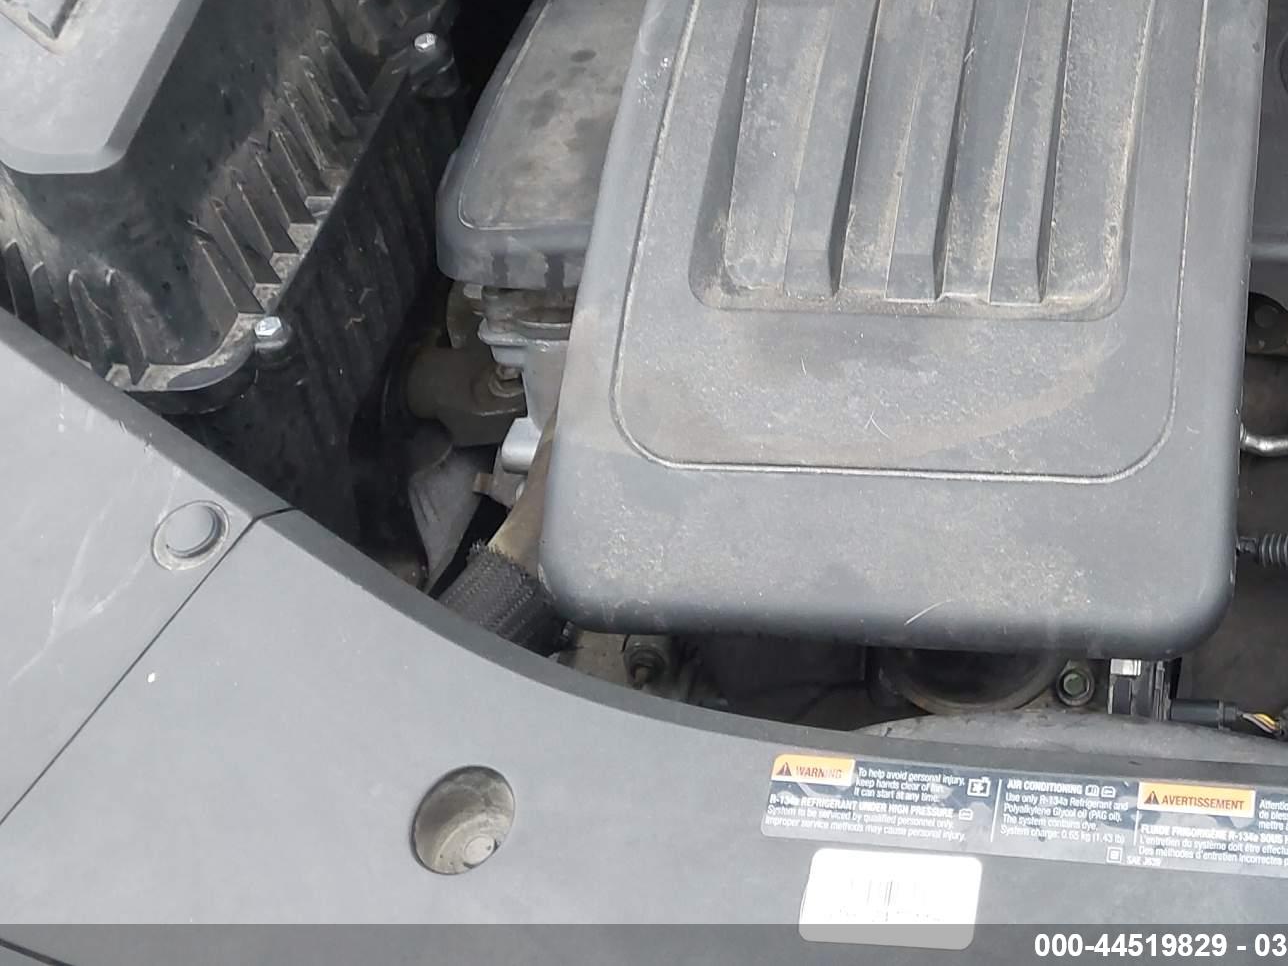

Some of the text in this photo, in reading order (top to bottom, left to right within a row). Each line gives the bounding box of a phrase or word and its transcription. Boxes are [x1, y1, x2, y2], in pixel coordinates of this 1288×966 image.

[795, 766, 842, 779] WARNING
[858, 768, 866, 777] To
[869, 769, 885, 778] help
[886, 771, 907, 779] avoid
[908, 773, 941, 783] personal
[876, 780, 899, 789] hands
[901, 782, 920, 790] clear
[922, 783, 929, 791] of
[1007, 779, 1082, 794] AIR CONDITIONING
[854, 788, 859, 796] It
[877, 790, 894, 798] start
[905, 793, 920, 802] any
[1006, 792, 1128, 810] Use only R-134a Refrigerant and
[1162, 795, 1245, 810] AVERTISSEMENT
[770, 793, 954, 818] R-134a REFRIGERANT UNDER HIGH PRESSURE
[1004, 803, 1051, 816] Polyalkylene
[1053, 806, 1076, 818] Glycol
[1077, 808, 1087, 817] oil
[1088, 809, 1105, 820] (PAG
[768, 804, 796, 815] System
[807, 808, 817, 816] be
[818, 809, 851, 819] serviced
[853, 812, 862, 822] by
[863, 814, 896, 825] qualified
[897, 816, 935, 827] personnel
[1259, 810, 1269, 818] de
[765, 816, 800, 827] Improper
[801, 820, 829, 829] service
[831, 822, 864, 832] methods
[865, 825, 882, 834] may
[884, 827, 908, 835] cause
[908, 828, 941, 838] personal
[1003, 814, 1097, 831] The system contains dye.
[1258, 820, 1283, 830] mettre
[1001, 825, 1029, 836] System
[1061, 830, 1078, 840] 0.65
[1081, 831, 1091, 842] kg
[1115, 834, 1125, 844] lb)
[1141, 824, 1170, 835] FLUIDE
[1229, 830, 1259, 842] R-134a
[1261, 833, 1283, 843] SOUS
[1140, 836, 1180, 846] L'entretien
[1182, 838, 1192, 847] du
[1194, 839, 1226, 851] système
[1228, 842, 1242, 851] doit
[1244, 842, 1260, 852] être
[1139, 846, 1153, 856] Des
[1156, 847, 1194, 859] méthodes
[1196, 850, 1238, 862] d'entretien
[1239, 854, 1282, 865] incorrectes
